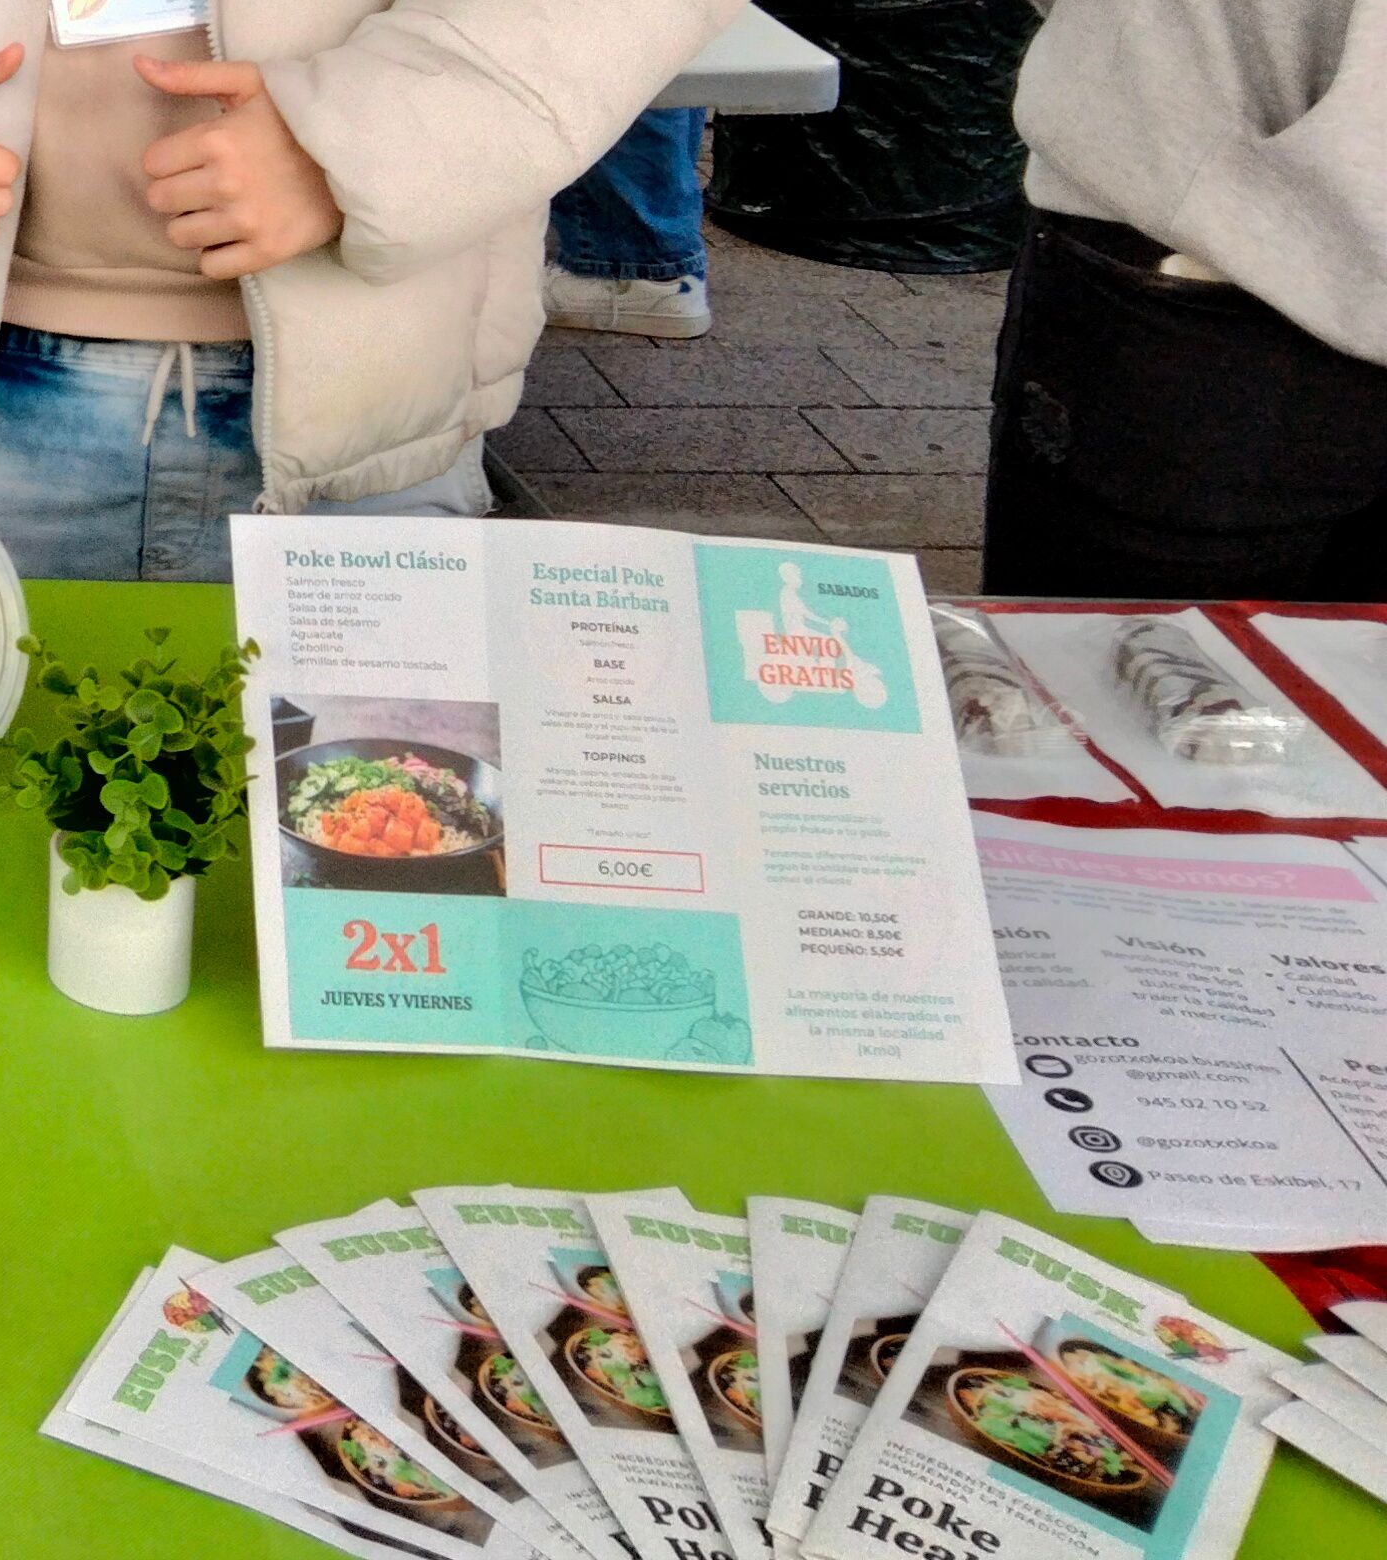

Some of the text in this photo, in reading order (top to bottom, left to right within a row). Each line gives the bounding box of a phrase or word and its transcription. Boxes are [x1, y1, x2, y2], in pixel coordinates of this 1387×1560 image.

[284, 549, 468, 572] Poke Bowl Clásico
[331, 576, 366, 589] fresco
[532, 562, 665, 588] Especial Poke
[287, 589, 315, 601] Base
[317, 590, 332, 601] de
[364, 590, 403, 603] cocido
[529, 587, 670, 613] Santa Bárbara
[288, 603, 360, 616] Salsa de soja
[289, 615, 335, 627] Salsa de
[290, 629, 344, 642] Aguacate
[761, 633, 844, 660] ENVIO
[291, 655, 449, 672] Semillas de tostadas
[593, 658, 627, 671] BASE
[758, 663, 855, 690] GRATIS
[592, 693, 633, 706] SALSA
[582, 750, 647, 765] TOPPINGS
[753, 752, 847, 775] Nuestros
[757, 778, 851, 799] servicios
[597, 860, 654, 879] 6,00€
[798, 909, 856, 923] GRANDE:
[799, 926, 864, 940] MEDIANO:
[342, 919, 447, 974] 2x1
[800, 942, 868, 956] PEQUEÑO:
[1115, 933, 1207, 958] Visión
[1269, 953, 1387, 976] Valores
[320, 989, 473, 1011] JUEVES Y VIERNES
[787, 987, 956, 1006] La de nuestros
[784, 1004, 963, 1025] alimentos elaborados en
[809, 1024, 946, 1042] la misma localidad
[1136, 1094, 1271, 1113] 945 02 10 52
[1147, 1169, 1214, 1186] Paseo
[1220, 1172, 1245, 1188] de
[452, 1204, 586, 1231] EUSK
[994, 1235, 1147, 1324] EUSK
[112, 1328, 191, 1413] EUSK
[877, 1456, 971, 1506] HAWAIANA
[880, 1447, 975, 1496] SIGUIENDO
[979, 1493, 1000, 1508] LA
[885, 1439, 1008, 1501] INGREDIENTES
[1011, 1497, 1090, 1540] FRESCOS
[864, 1473, 1002, 1555] Poke
